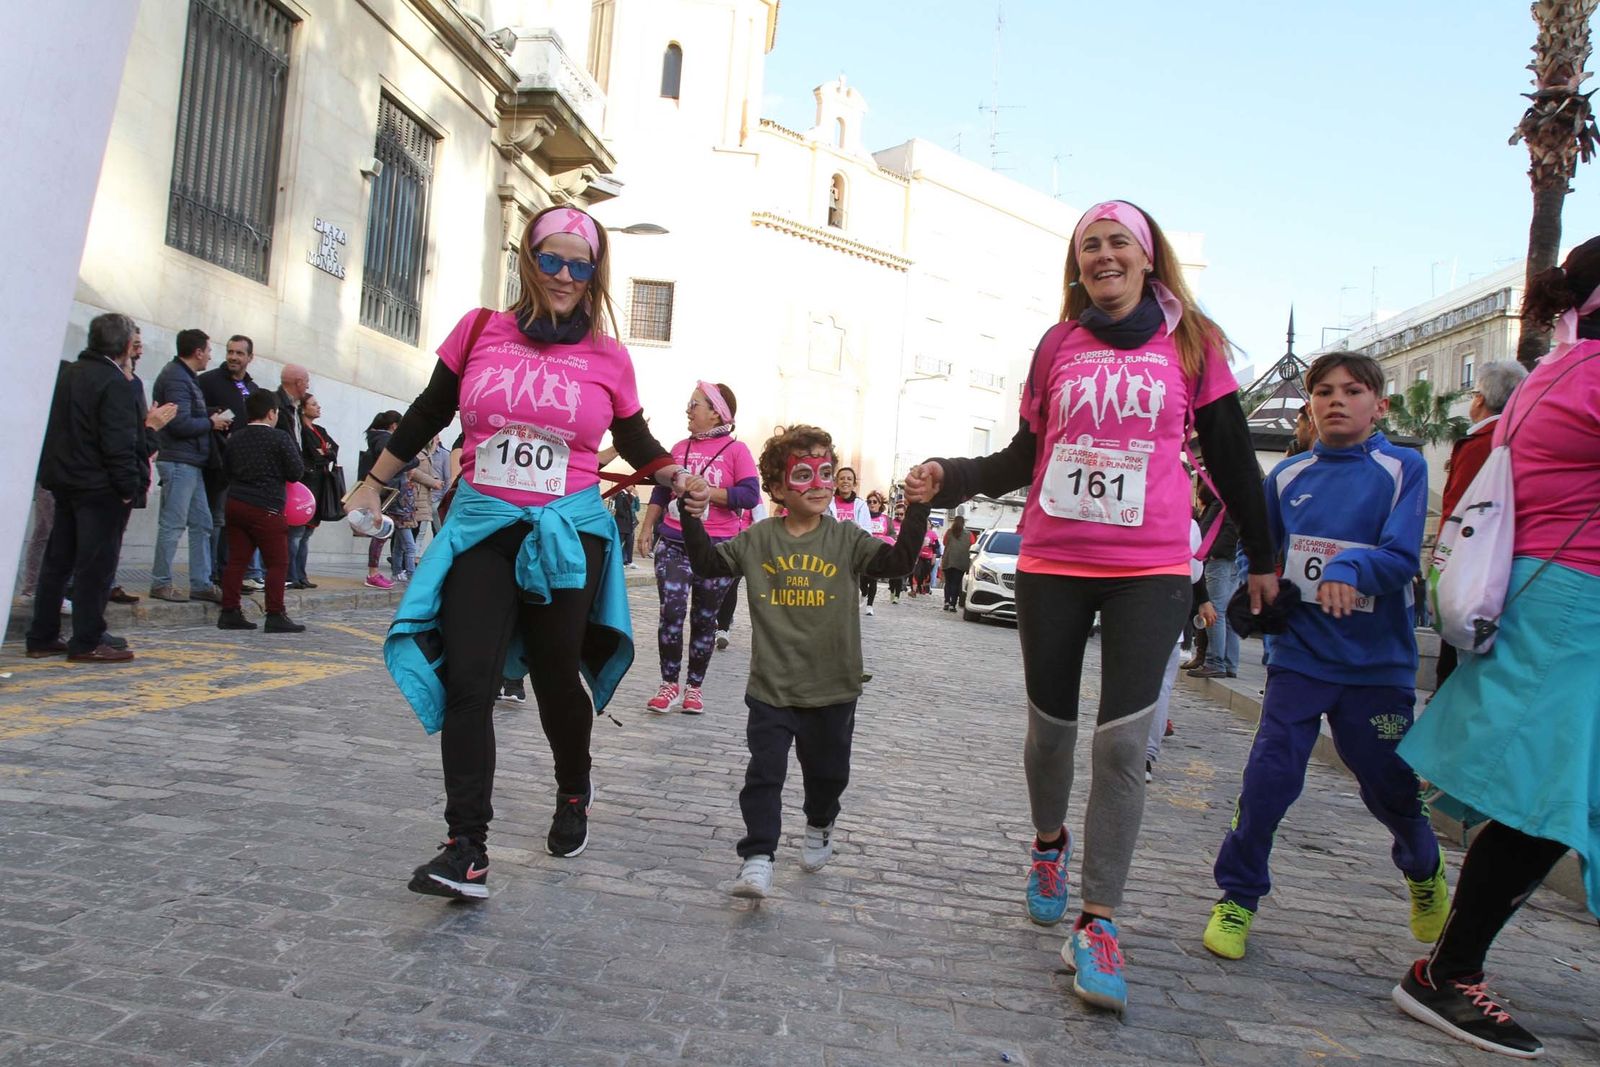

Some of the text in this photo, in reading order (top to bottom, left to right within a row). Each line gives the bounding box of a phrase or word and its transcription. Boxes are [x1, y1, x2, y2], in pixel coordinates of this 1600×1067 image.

[313, 217, 346, 246] PLAZA
[322, 234, 337, 251] DE
[319, 242, 338, 263] LAS
[306, 250, 346, 279] MONJAS
[486, 345, 497, 353] DE
[509, 348, 539, 360] MUJER
[547, 355, 589, 371] RUNNING
[503, 341, 589, 365] CARRERA PINK
[1073, 349, 1115, 361] CARRERA
[1084, 356, 1115, 364] MUJER
[1125, 355, 1168, 367] RUNNING
[496, 439, 554, 471] 160
[1068, 448, 1098, 459] CARRERA
[1125, 455, 1143, 464] PINK
[1075, 456, 1098, 467] MUJER
[1106, 459, 1143, 472] RUNNING
[1067, 468, 1125, 502] 161
[1306, 539, 1336, 549] CARRERA
[1311, 547, 1336, 555] MUJER
[761, 553, 838, 578] NACIDO
[786, 575, 810, 588] PARA
[770, 588, 826, 607] LUCHAR
[1383, 722, 1398, 735] 98
